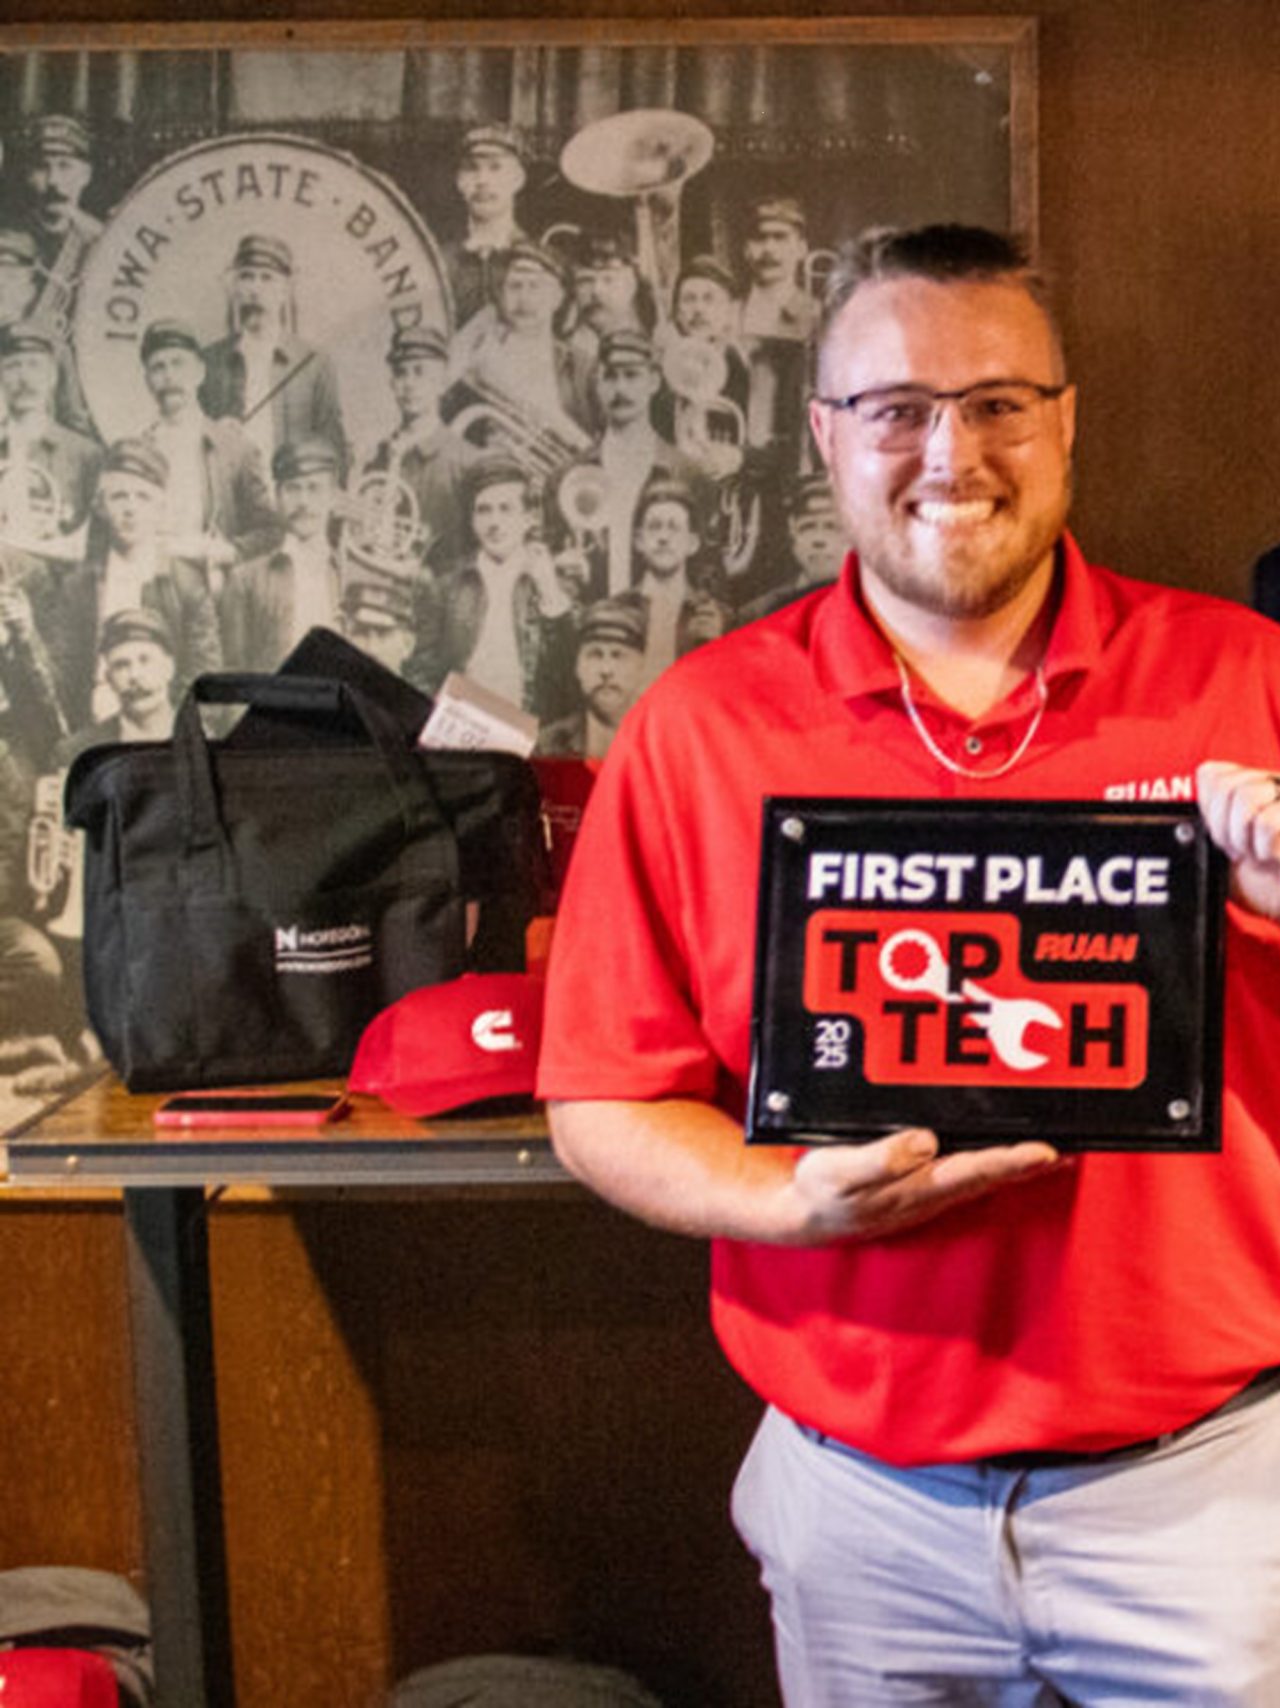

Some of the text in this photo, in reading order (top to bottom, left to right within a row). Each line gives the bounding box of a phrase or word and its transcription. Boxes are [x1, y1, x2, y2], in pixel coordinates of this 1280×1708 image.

[105, 163, 423, 342] IOWA STATE BAND
[807, 853, 1170, 905] FIRST PLACE
[822, 928, 1002, 994] TOP
[1034, 932, 1140, 963] RUAN
[882, 998, 1127, 1070] TECH
